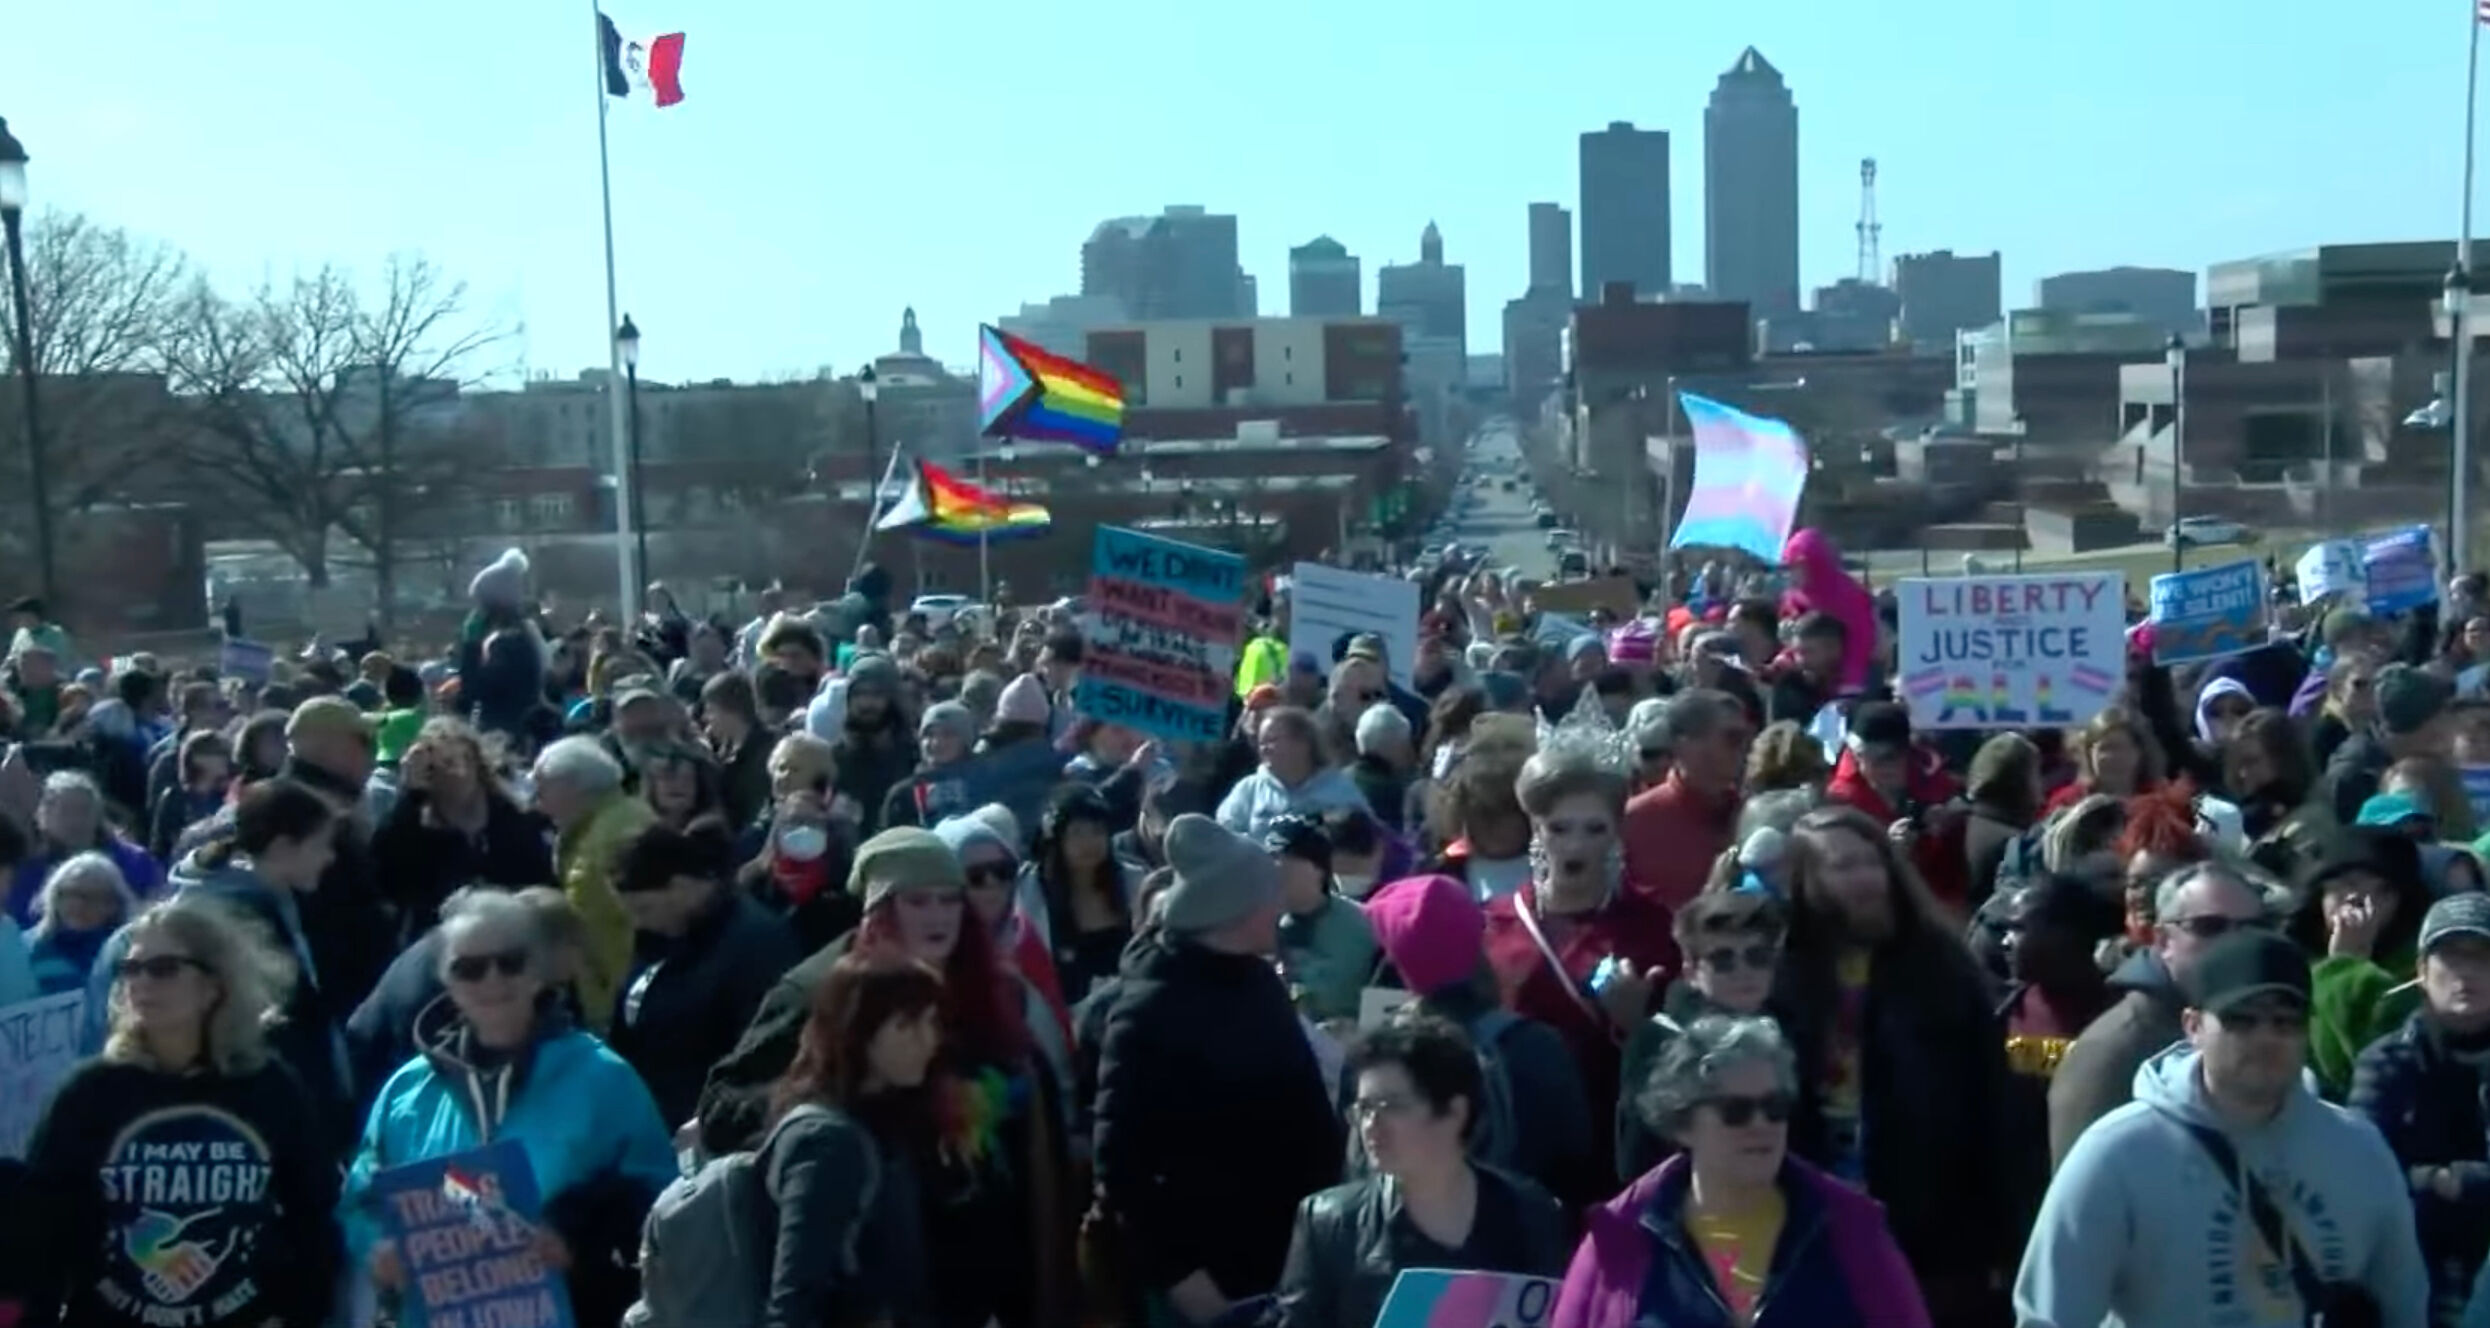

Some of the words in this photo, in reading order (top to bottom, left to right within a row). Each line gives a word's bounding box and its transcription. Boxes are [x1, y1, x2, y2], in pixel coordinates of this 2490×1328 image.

[1105, 534, 1157, 579] WE
[1926, 580, 2107, 615] LIBERTY
[2154, 580, 2182, 601] WE
[1920, 626, 2090, 663] JUSTICE
[1101, 685, 1219, 736] SURVIVE
[1938, 673, 2073, 722] ALL
[128, 1141, 137, 1160] I
[143, 1141, 204, 1160] MAY
[210, 1141, 247, 1160] BE
[406, 1218, 530, 1269] PEOPLE
[421, 1251, 546, 1306] BELONG
